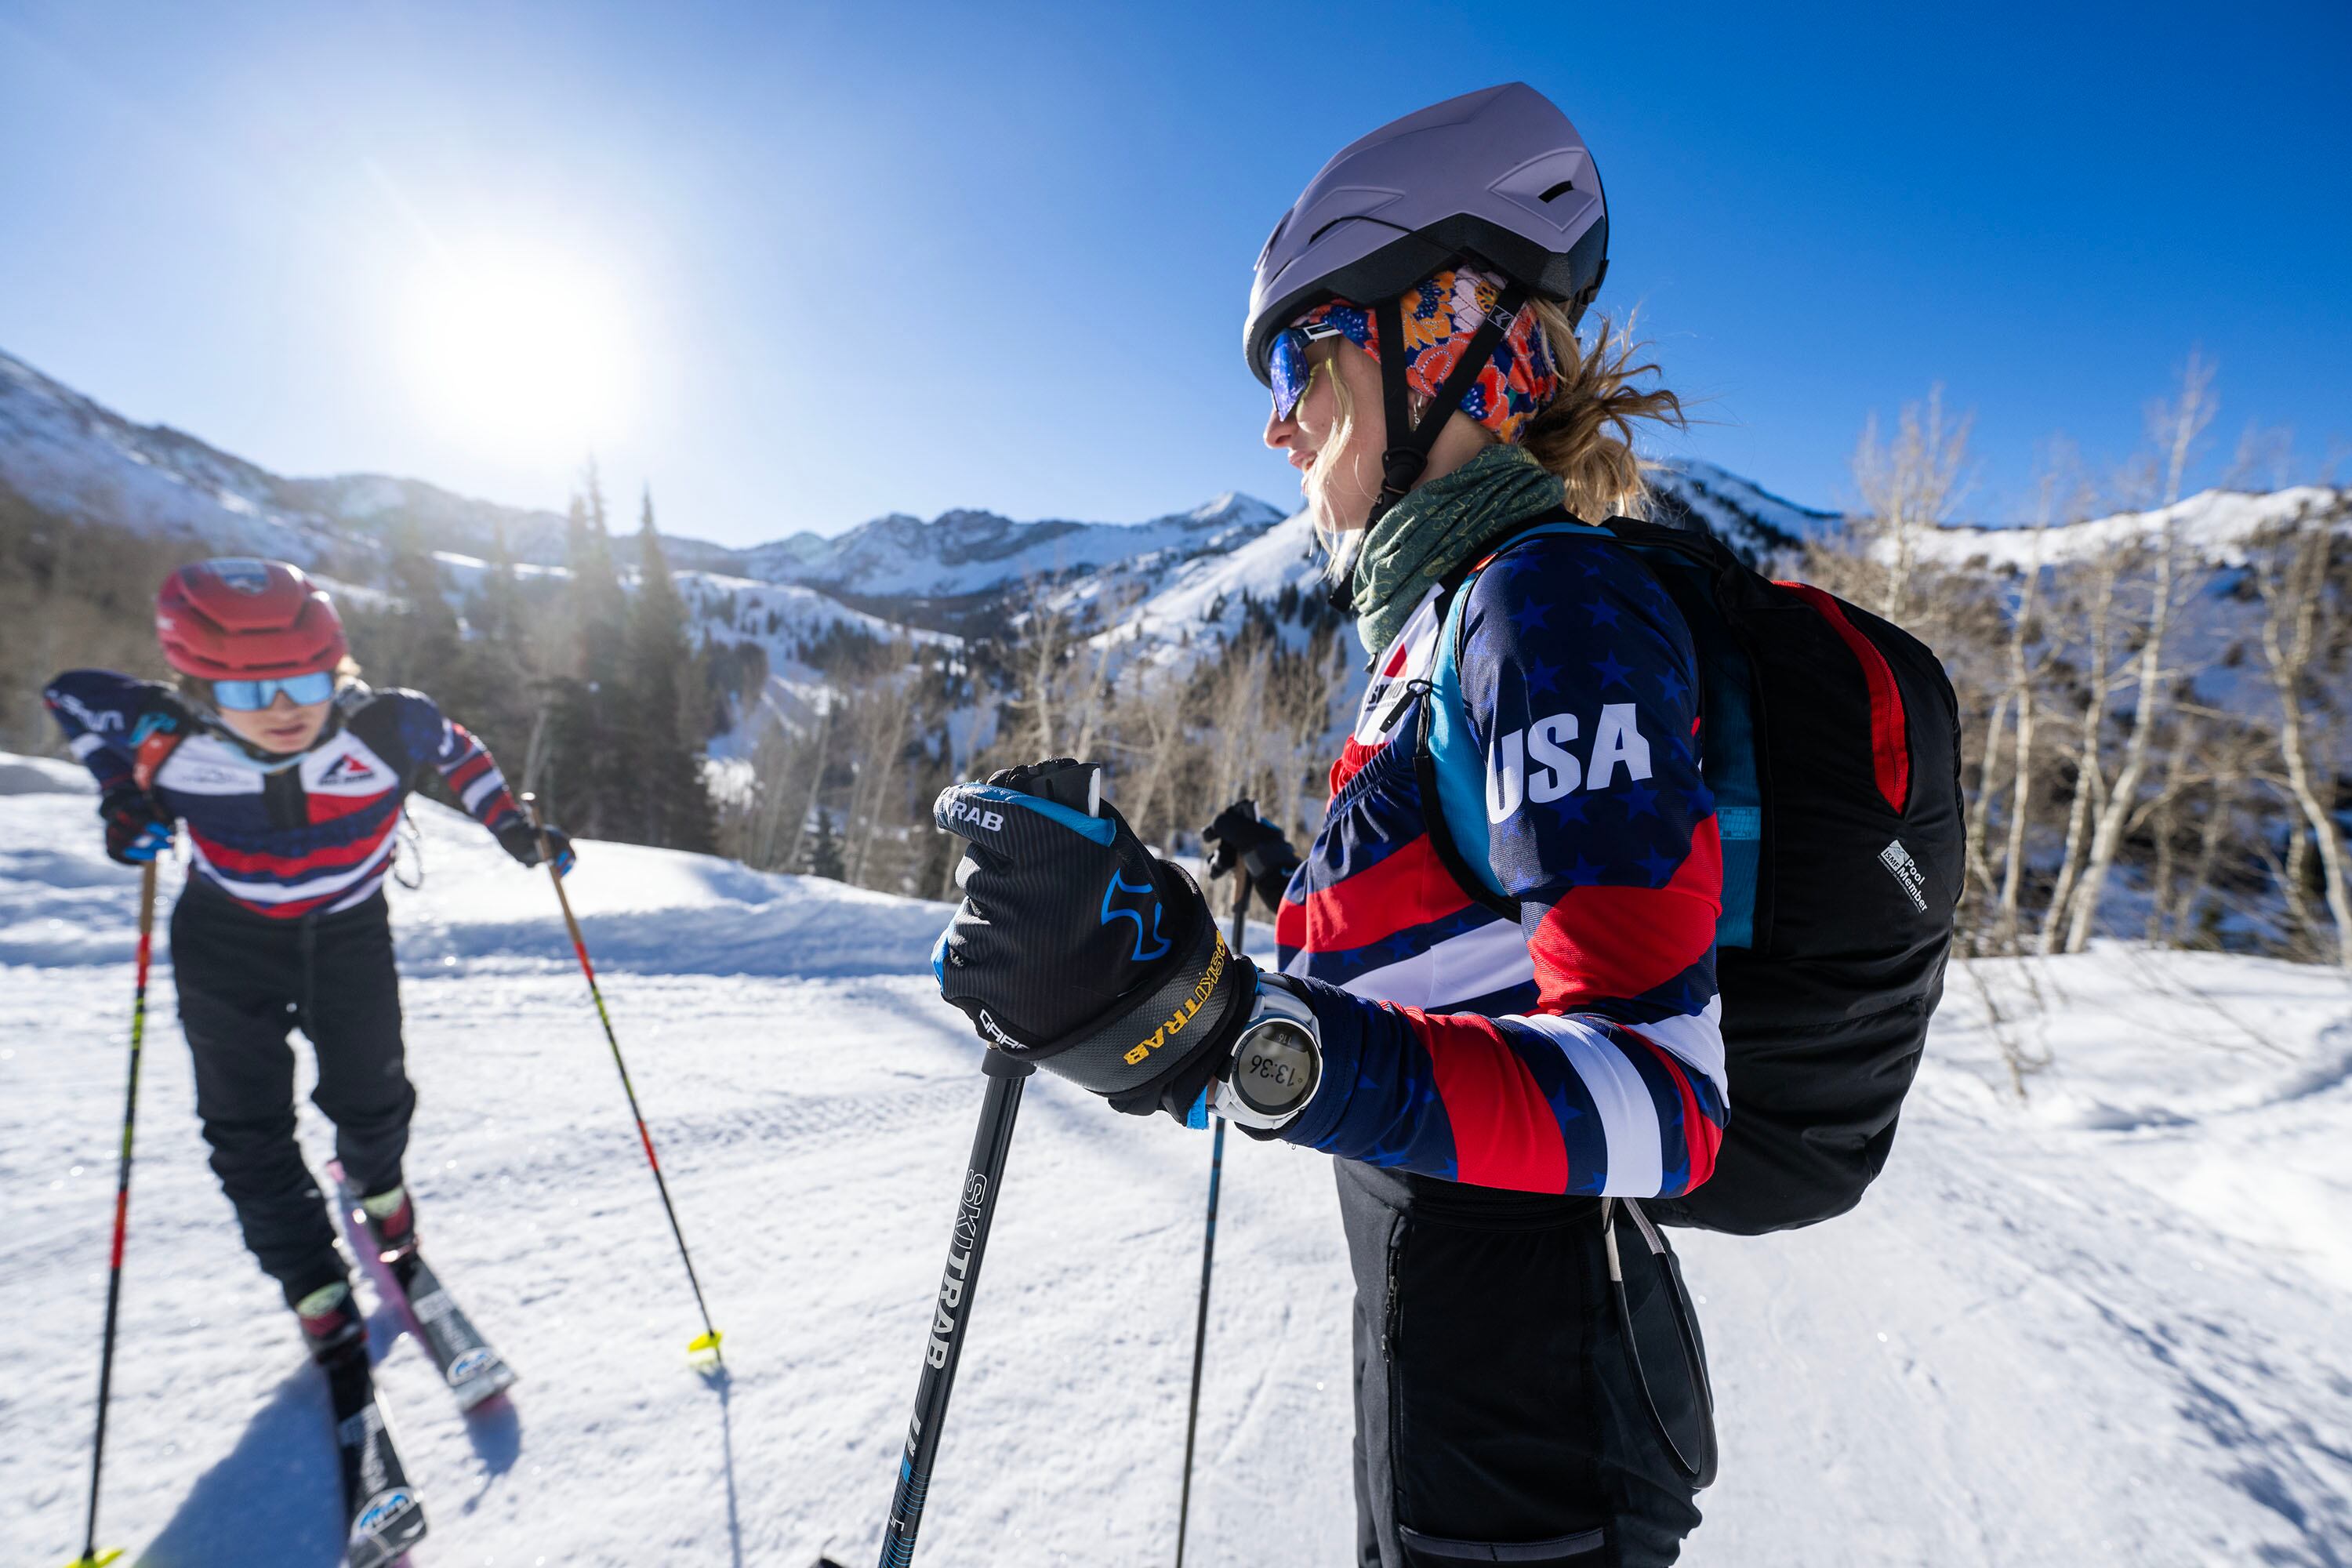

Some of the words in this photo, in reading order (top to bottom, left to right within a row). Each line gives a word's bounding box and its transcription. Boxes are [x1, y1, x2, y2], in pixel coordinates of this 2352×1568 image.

[1486, 703, 1653, 824] USA
[1883, 851, 1900, 869] ISMF
[1904, 858, 1926, 885] Pool
[1896, 866, 1928, 911] Member
[1278, 1033, 1292, 1046] 116
[1249, 1054, 1296, 1087] 13:36
